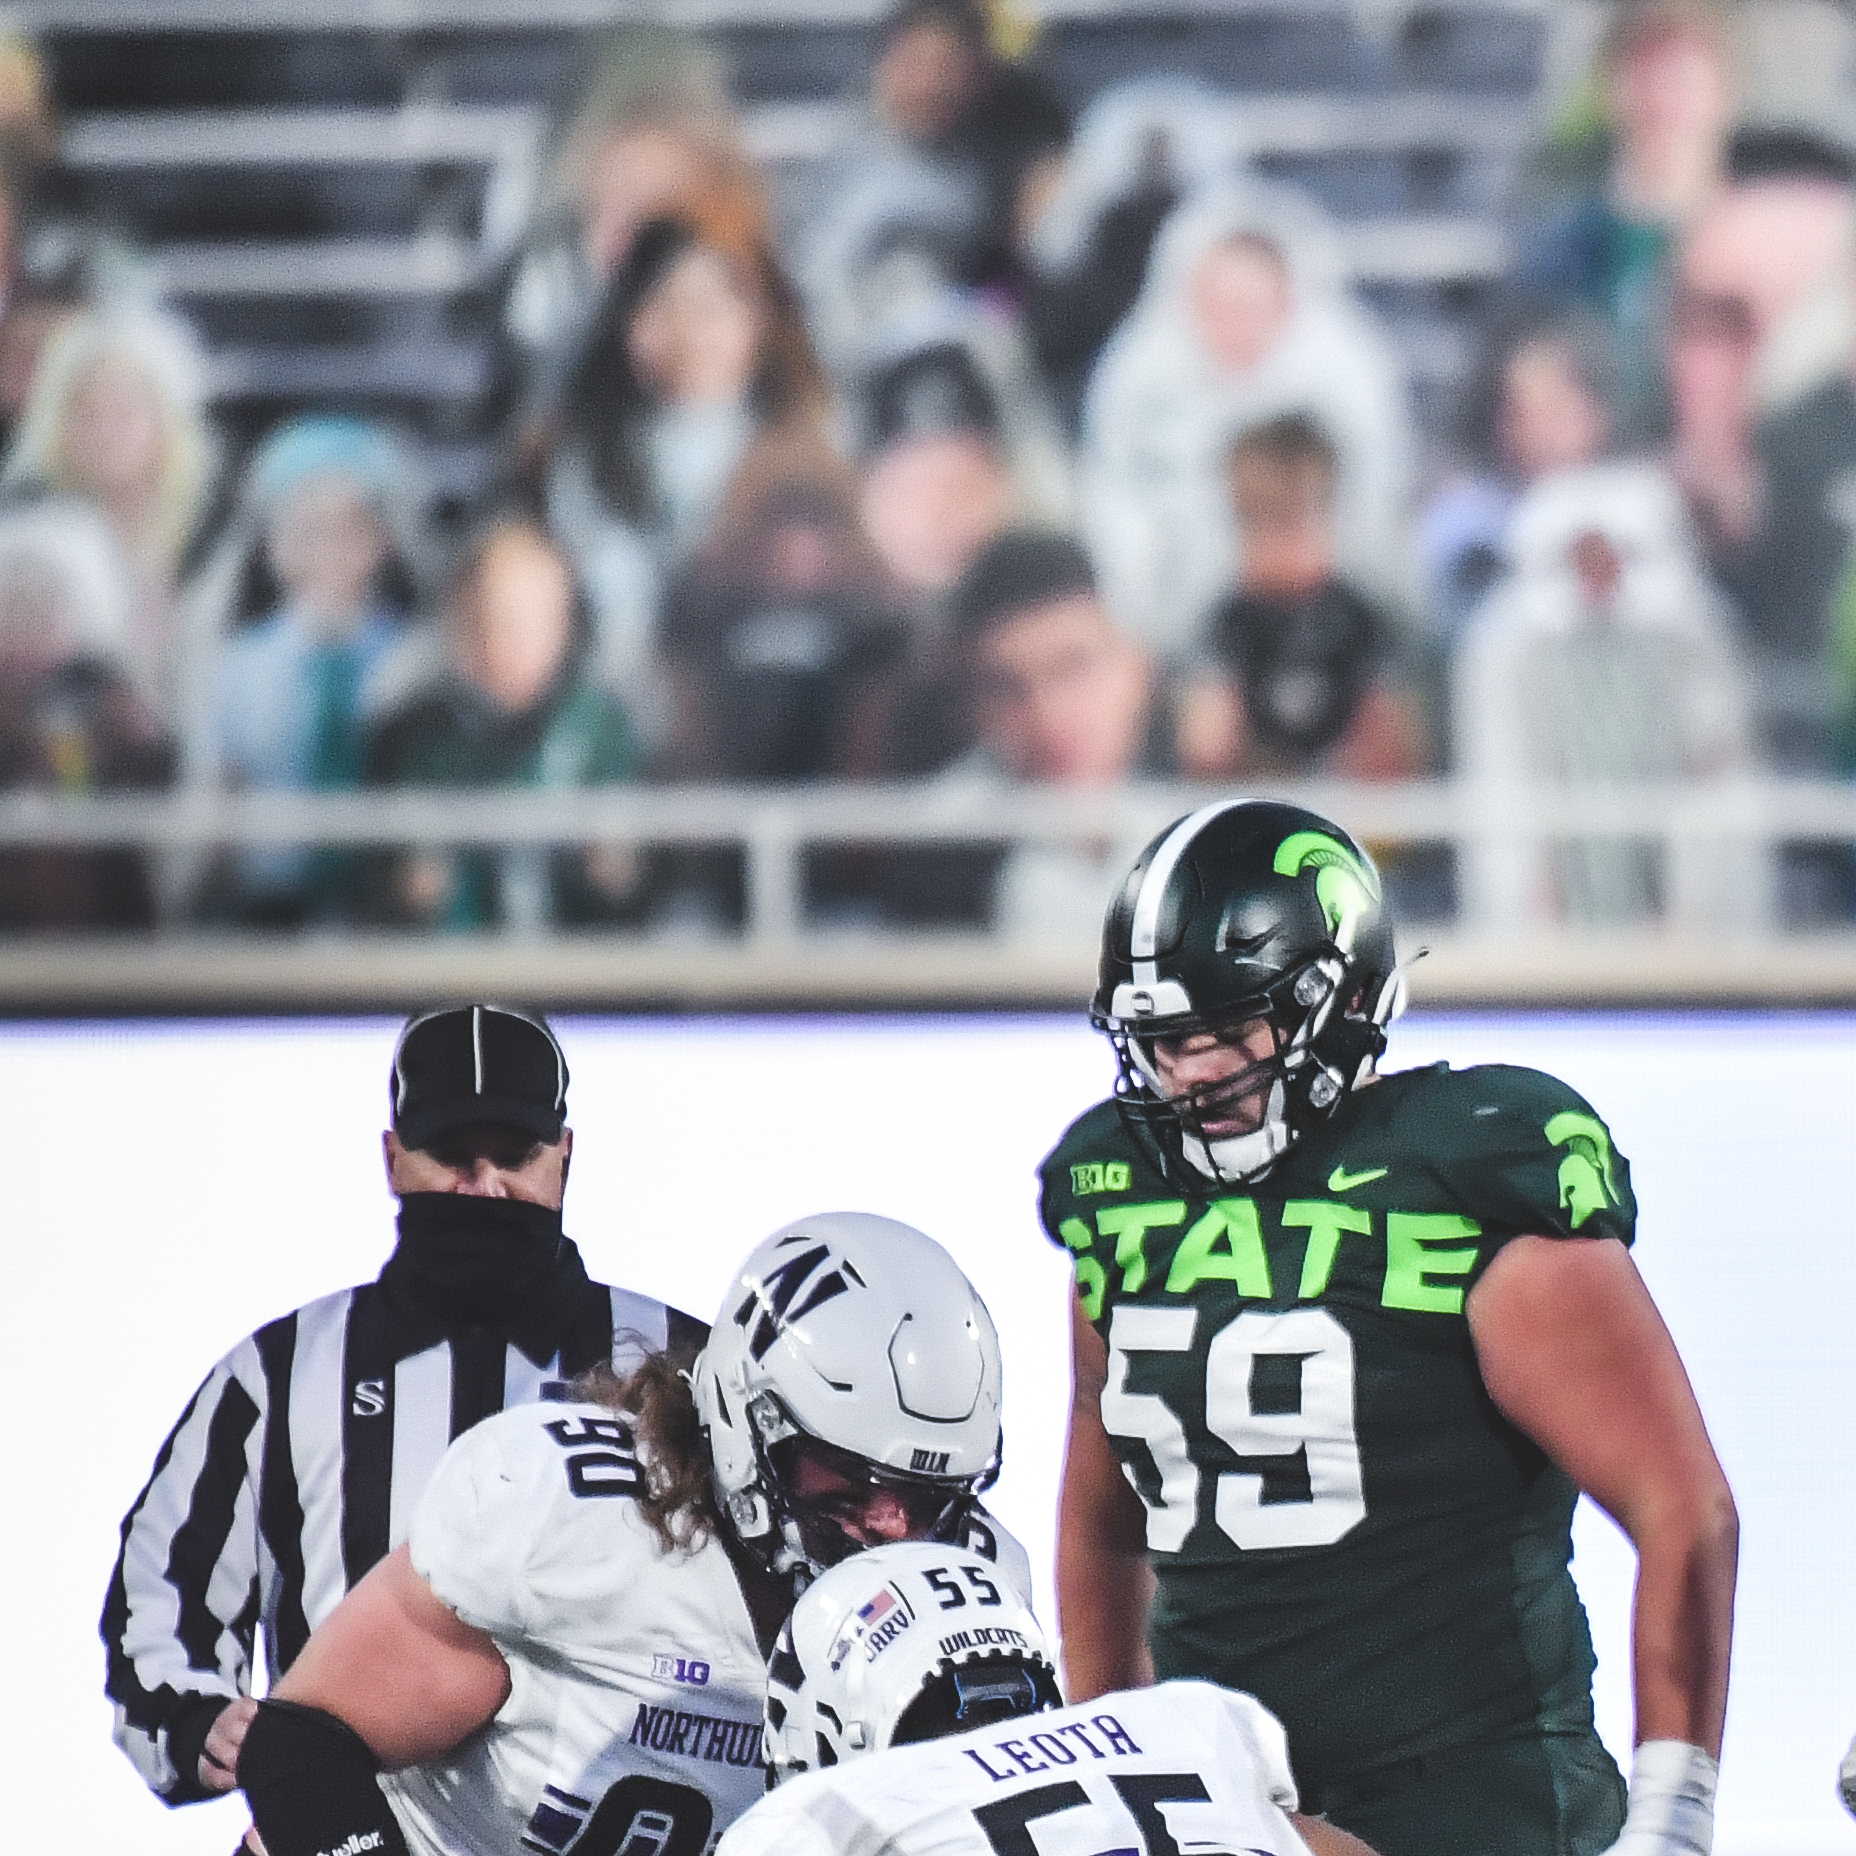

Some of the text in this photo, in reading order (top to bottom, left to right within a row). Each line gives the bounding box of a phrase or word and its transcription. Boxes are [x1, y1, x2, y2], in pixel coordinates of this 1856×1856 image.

[1059, 1198, 1484, 1322] STATE
[353, 1381, 386, 1416] S
[1100, 1305, 1368, 1553] 59
[921, 1565, 1002, 1611] 55
[865, 1609, 911, 1663] JARV
[938, 1627, 1029, 1657] WILDCATS
[962, 1713, 1144, 1783] LEOTA
